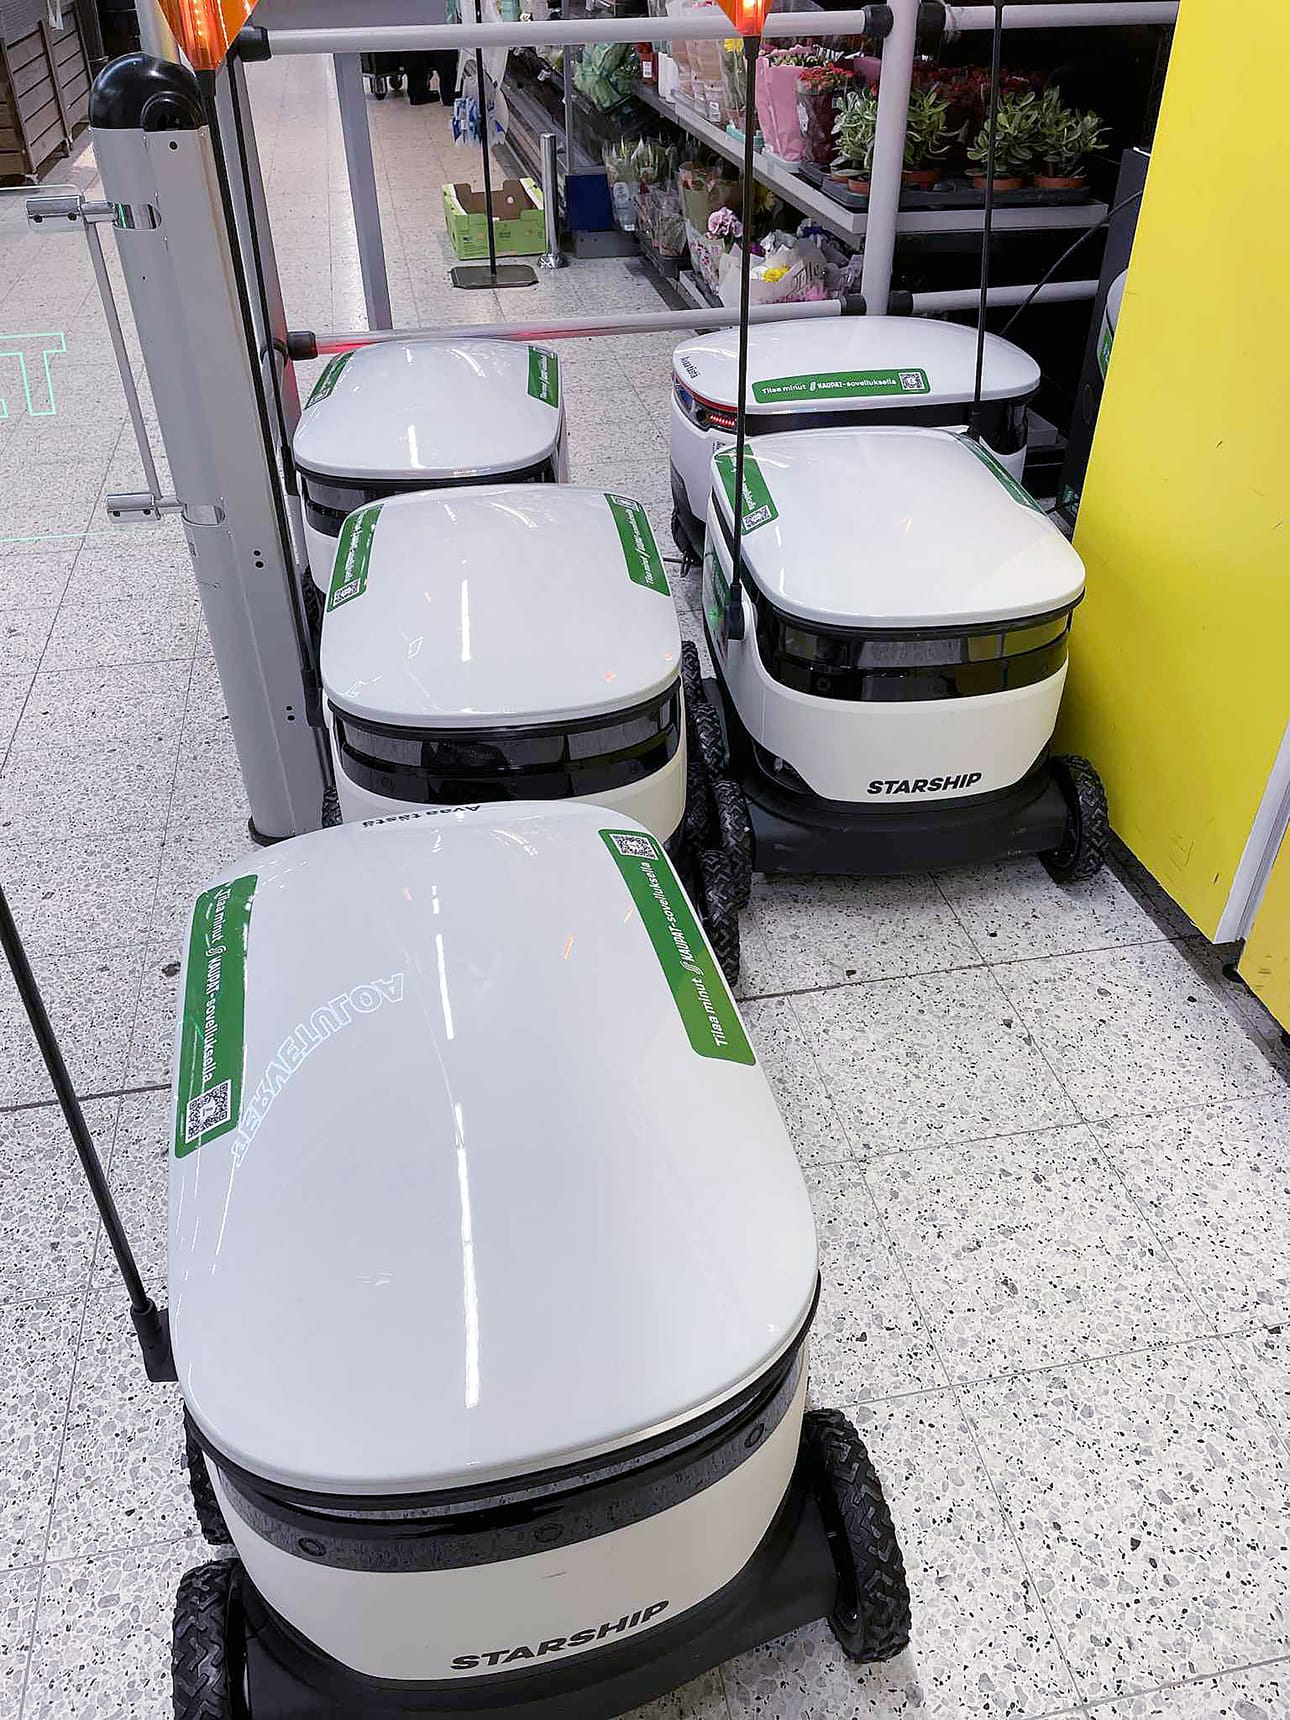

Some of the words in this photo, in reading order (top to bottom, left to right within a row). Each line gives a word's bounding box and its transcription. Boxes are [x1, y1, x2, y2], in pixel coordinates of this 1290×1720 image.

[867, 772, 982, 795] STARSHIP
[424, 805, 480, 816] Avaa
[215, 888, 231, 912] Tilaa
[640, 861, 695, 962] KAUPAT-sovelluksella
[211, 911, 225, 944] minut
[692, 977, 715, 1014] minut
[203, 955, 222, 1083] KAUPAT-sovelluksella
[709, 1015, 728, 1047] Tilaa
[450, 1600, 669, 1670] STARSHIP
